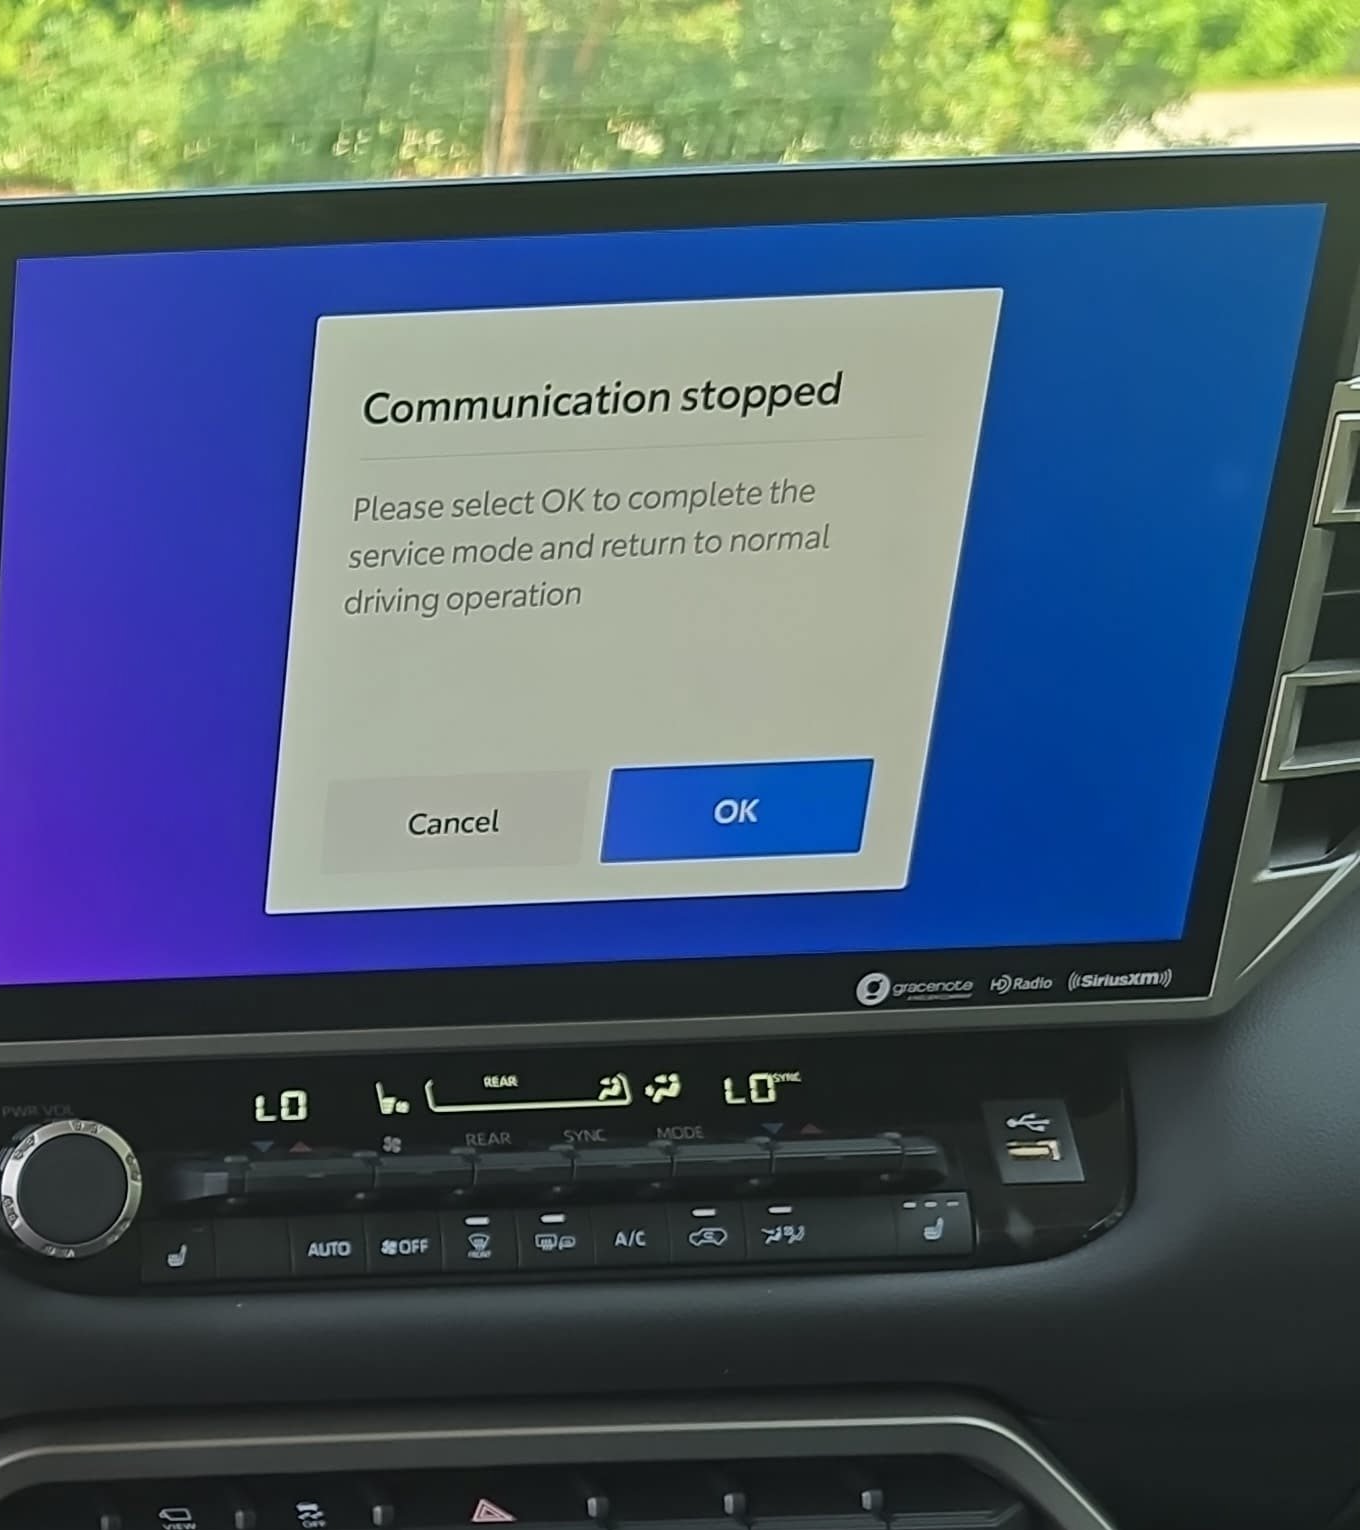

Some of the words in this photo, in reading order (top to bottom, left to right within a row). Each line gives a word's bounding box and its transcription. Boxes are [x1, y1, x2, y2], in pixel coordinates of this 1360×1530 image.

[363, 379, 671, 425] Communication
[680, 371, 843, 416] stopped
[353, 495, 444, 522] Please
[450, 490, 534, 518] select
[540, 488, 586, 514] OK
[591, 487, 621, 512] to
[627, 481, 762, 517] complete
[769, 478, 816, 504] the
[347, 543, 445, 569] service
[452, 537, 533, 563] mode
[539, 533, 594, 561] and
[600, 531, 686, 558] return
[693, 529, 721, 554] to
[729, 524, 830, 553] normal
[344, 588, 439, 618] driving
[445, 582, 582, 617] operation
[713, 798, 760, 825] OK
[407, 810, 500, 836] Cancel
[892, 980, 974, 996] gracenote
[1013, 977, 1053, 991] Radio
[483, 1074, 519, 1088] REAR
[725, 1073, 776, 1104] LO
[1, 1105, 38, 1119] PWR
[40, 1103, 74, 1118] VOL
[255, 1089, 308, 1122] LO
[465, 1131, 512, 1147] REAR
[563, 1127, 608, 1144] SYNC
[656, 1124, 705, 1141] MODE
[398, 1238, 430, 1255] OFF
[614, 1230, 647, 1247] A/C
[307, 1241, 352, 1257] AUTO
[162, 1522, 197, 1530] VIEW
[302, 1518, 327, 1529] OFF
